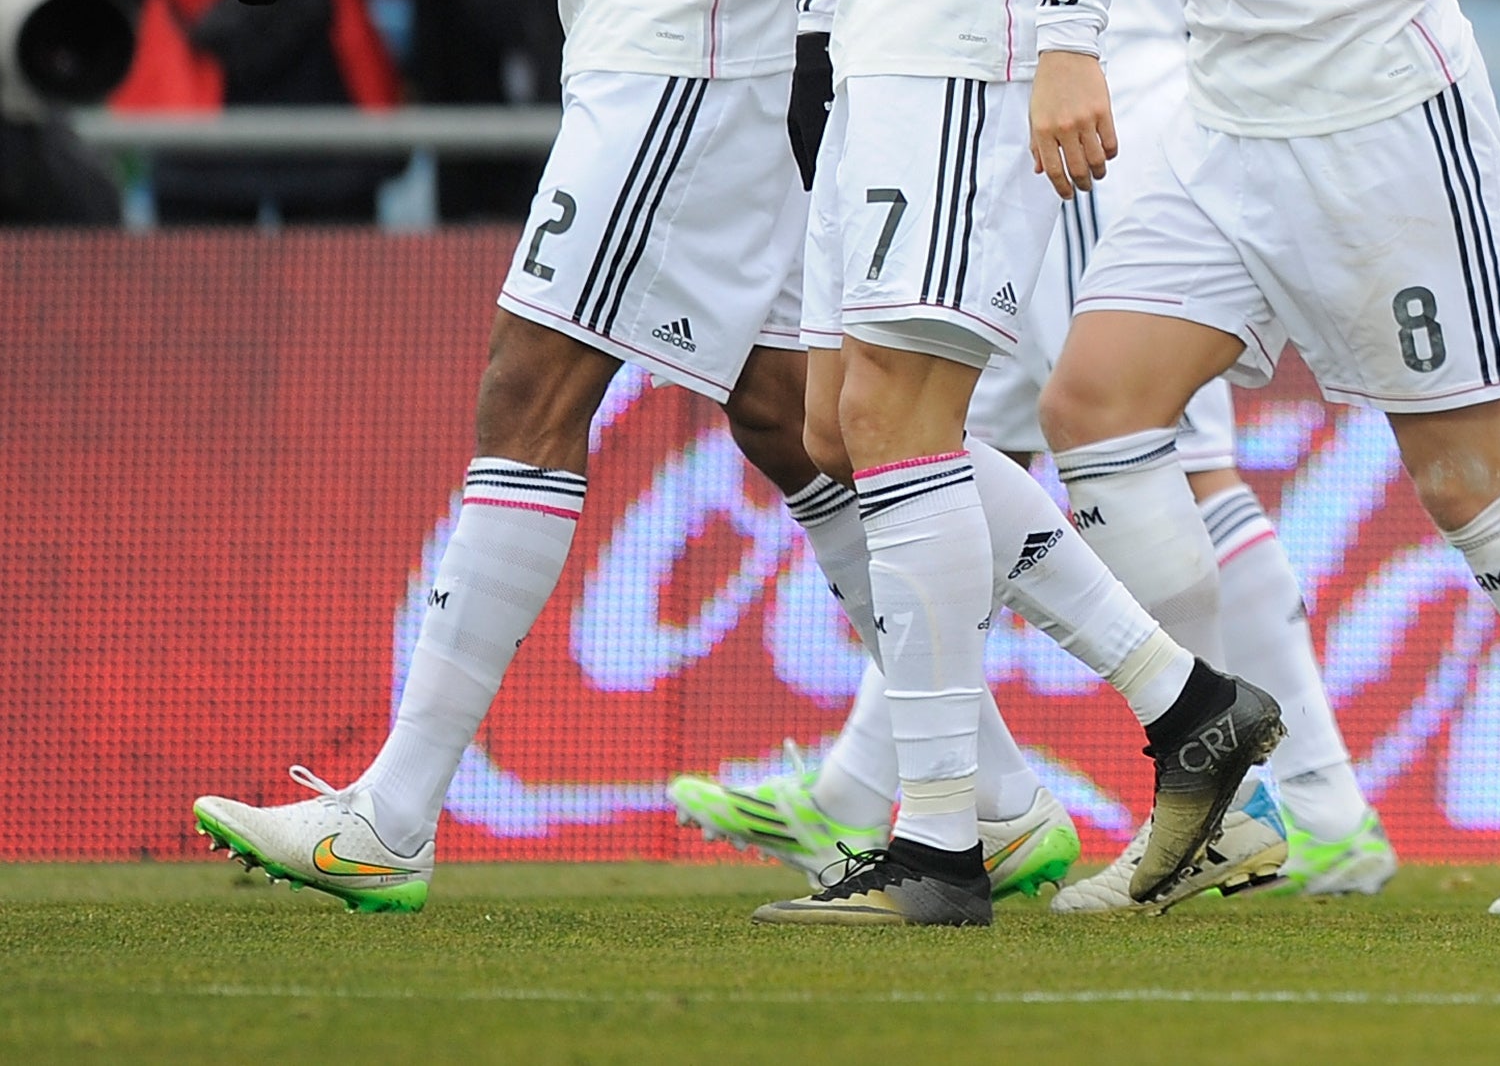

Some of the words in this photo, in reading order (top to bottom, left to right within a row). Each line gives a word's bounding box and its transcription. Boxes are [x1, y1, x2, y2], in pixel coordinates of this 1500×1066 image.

[523, 189, 577, 282] 2
[866, 188, 908, 281] 7
[652, 328, 697, 353] adidas
[1392, 286, 1447, 373] 8
[1179, 713, 1239, 773] CR7
